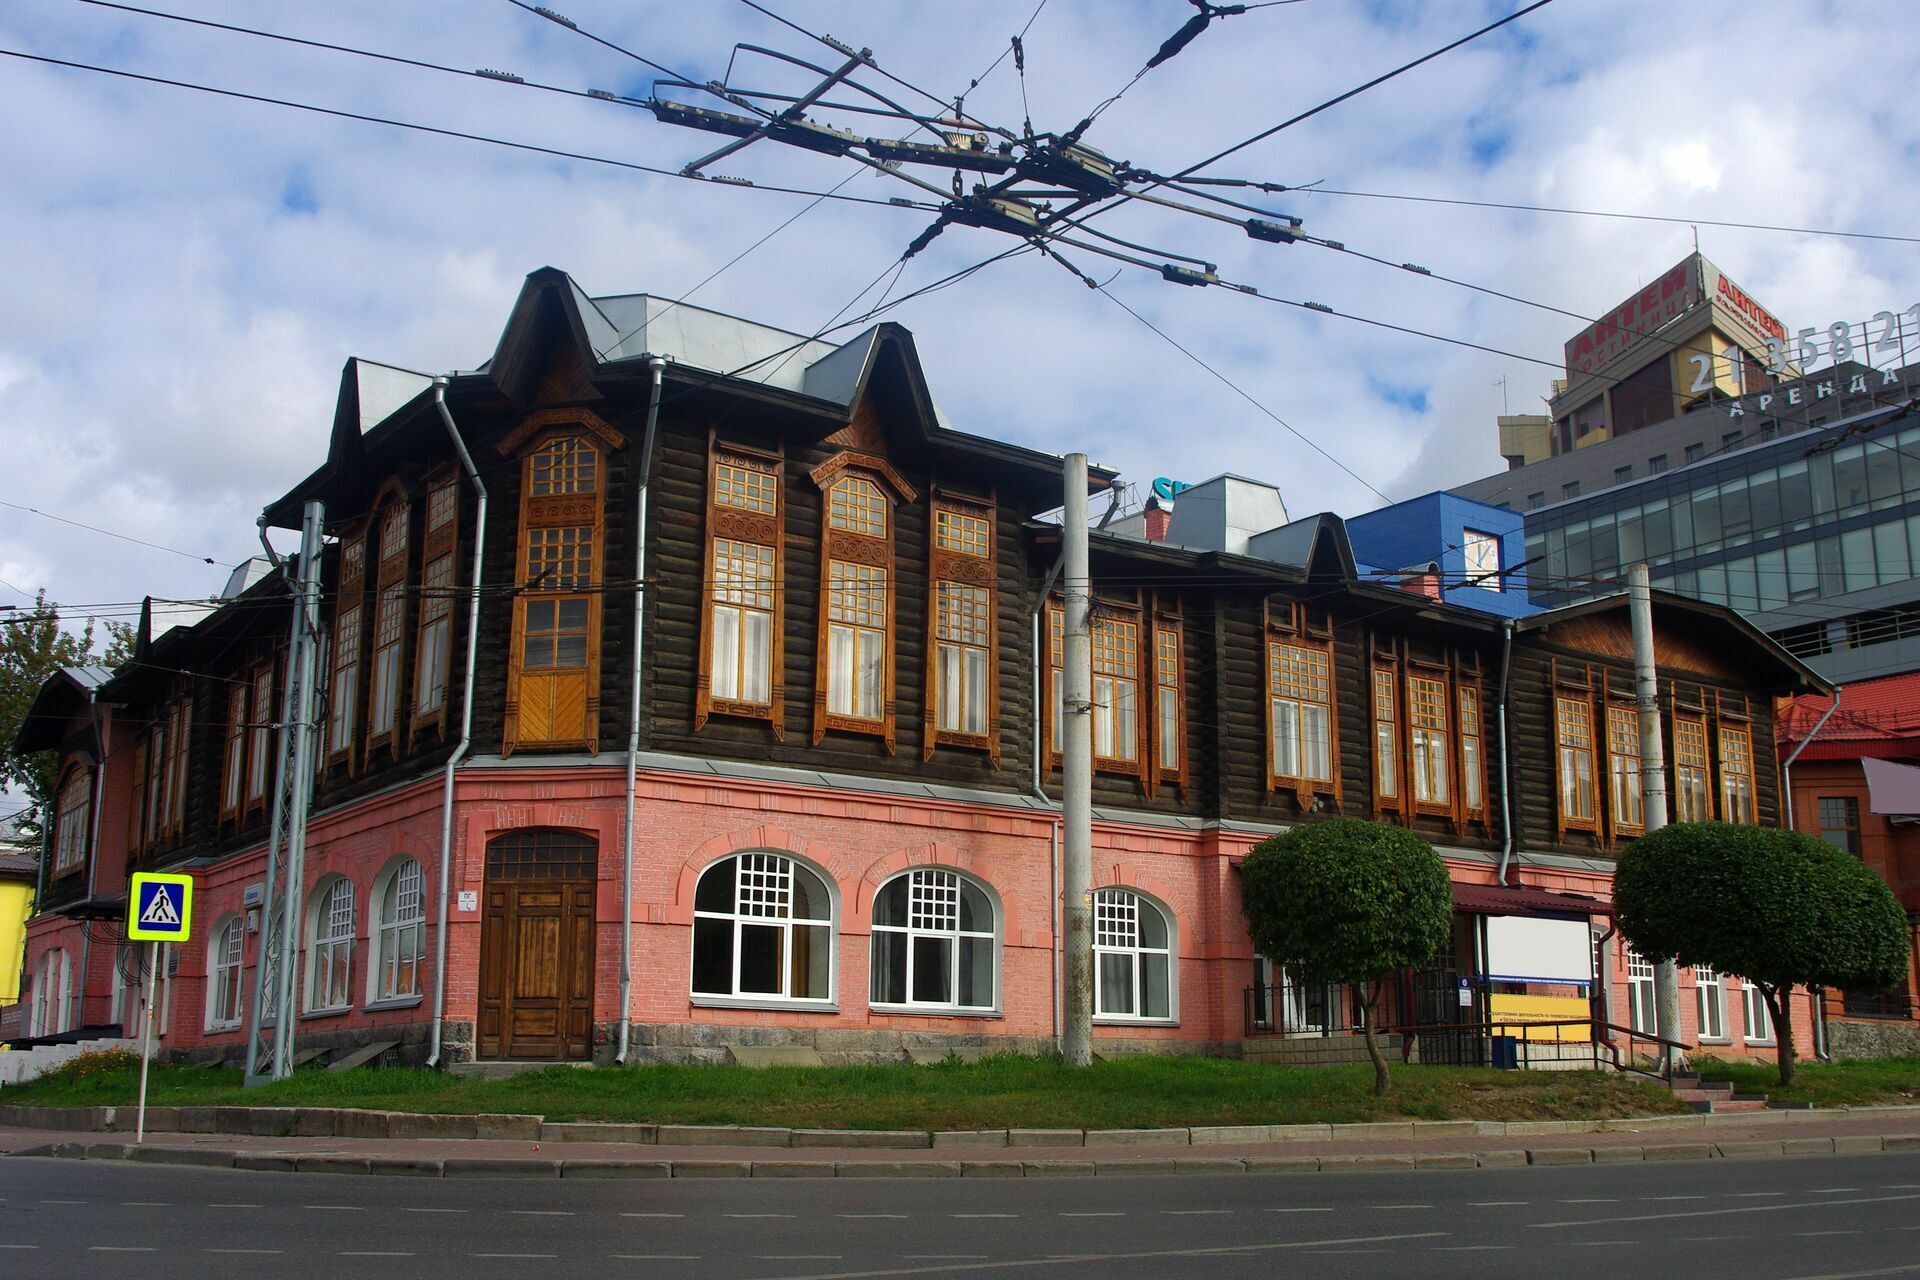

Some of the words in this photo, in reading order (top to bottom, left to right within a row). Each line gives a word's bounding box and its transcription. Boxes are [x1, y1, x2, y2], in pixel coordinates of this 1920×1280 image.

[1572, 265, 1686, 364] АНТЕЙ
[1718, 274, 1785, 345] АНТЕЙ
[1729, 367, 1898, 418] АРЕНДА
